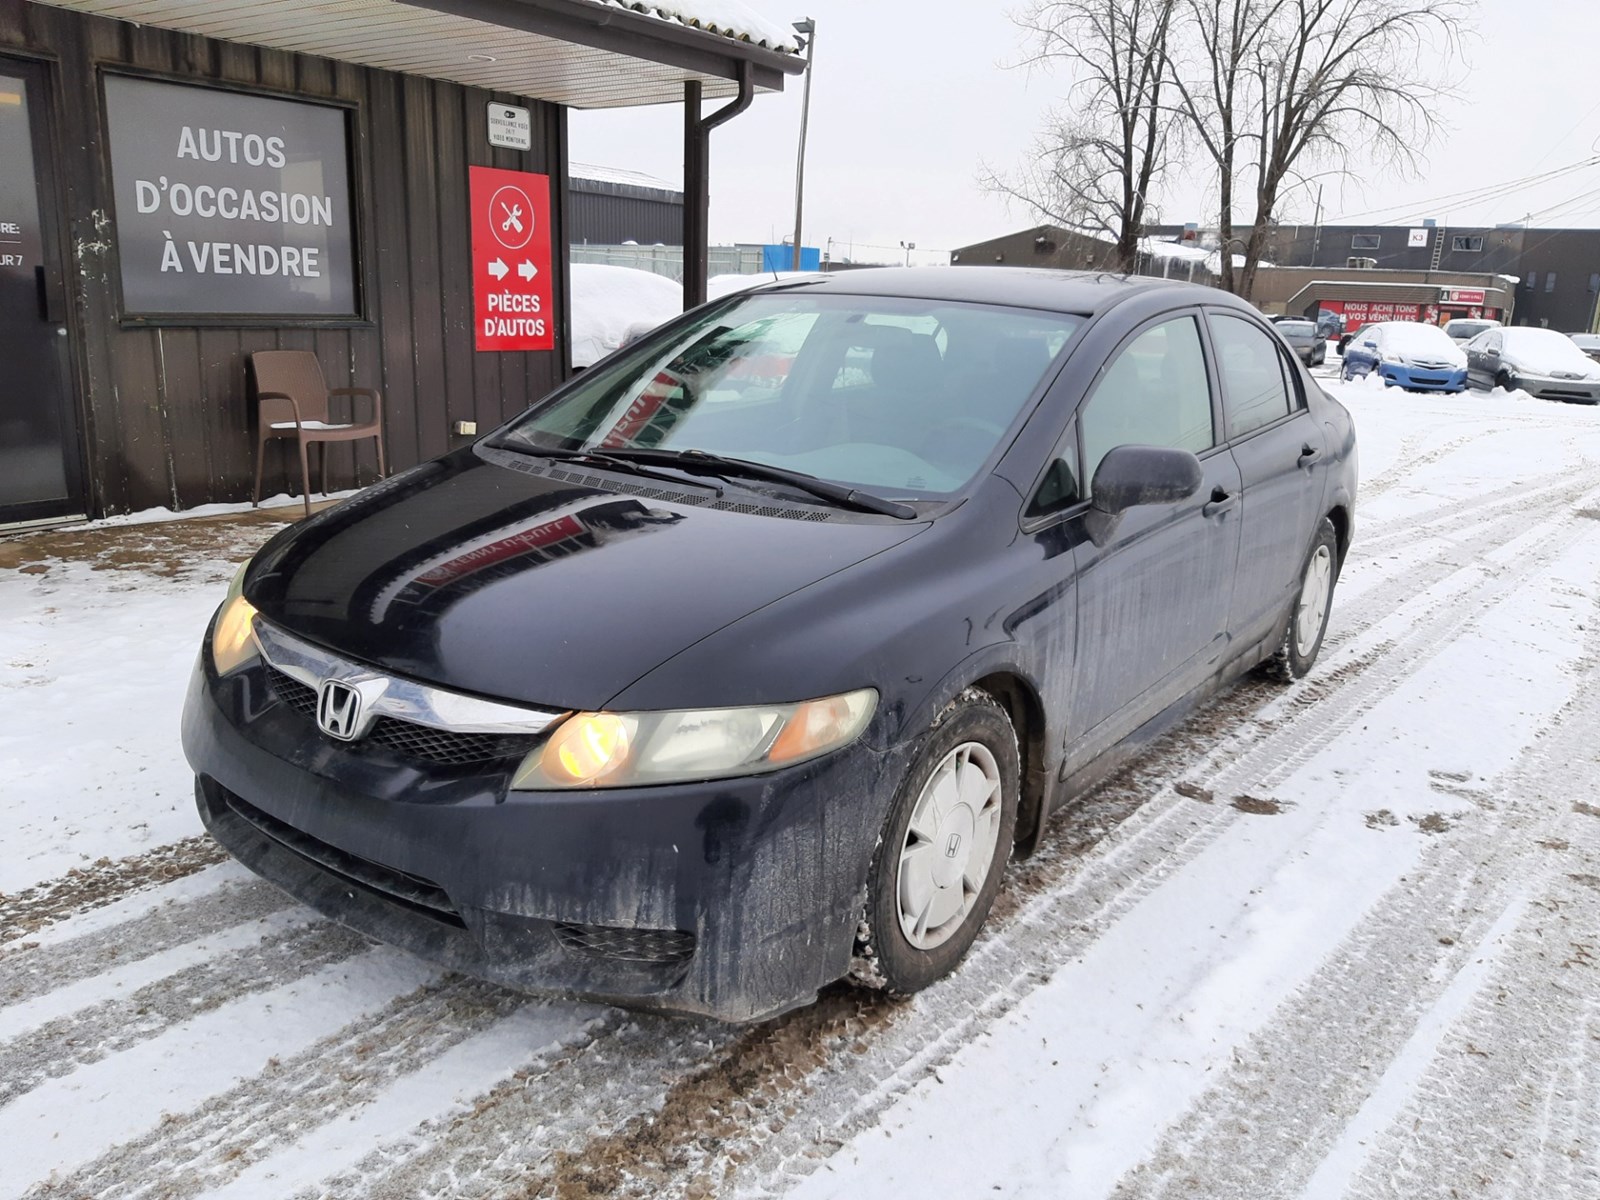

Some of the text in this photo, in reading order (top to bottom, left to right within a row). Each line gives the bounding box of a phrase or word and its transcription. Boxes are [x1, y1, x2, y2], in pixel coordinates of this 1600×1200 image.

[177, 126, 286, 168] AUTOS
[135, 176, 332, 226] D’OCCASION
[0, 222, 20, 234] RE:
[15, 254, 23, 266] 7
[160, 230, 320, 277] À VENDRE
[488, 289, 541, 313] PIÈCES
[1344, 303, 1368, 311] NOUS
[484, 316, 545, 337] D'AUTOS
[1348, 312, 1367, 320] VOS
